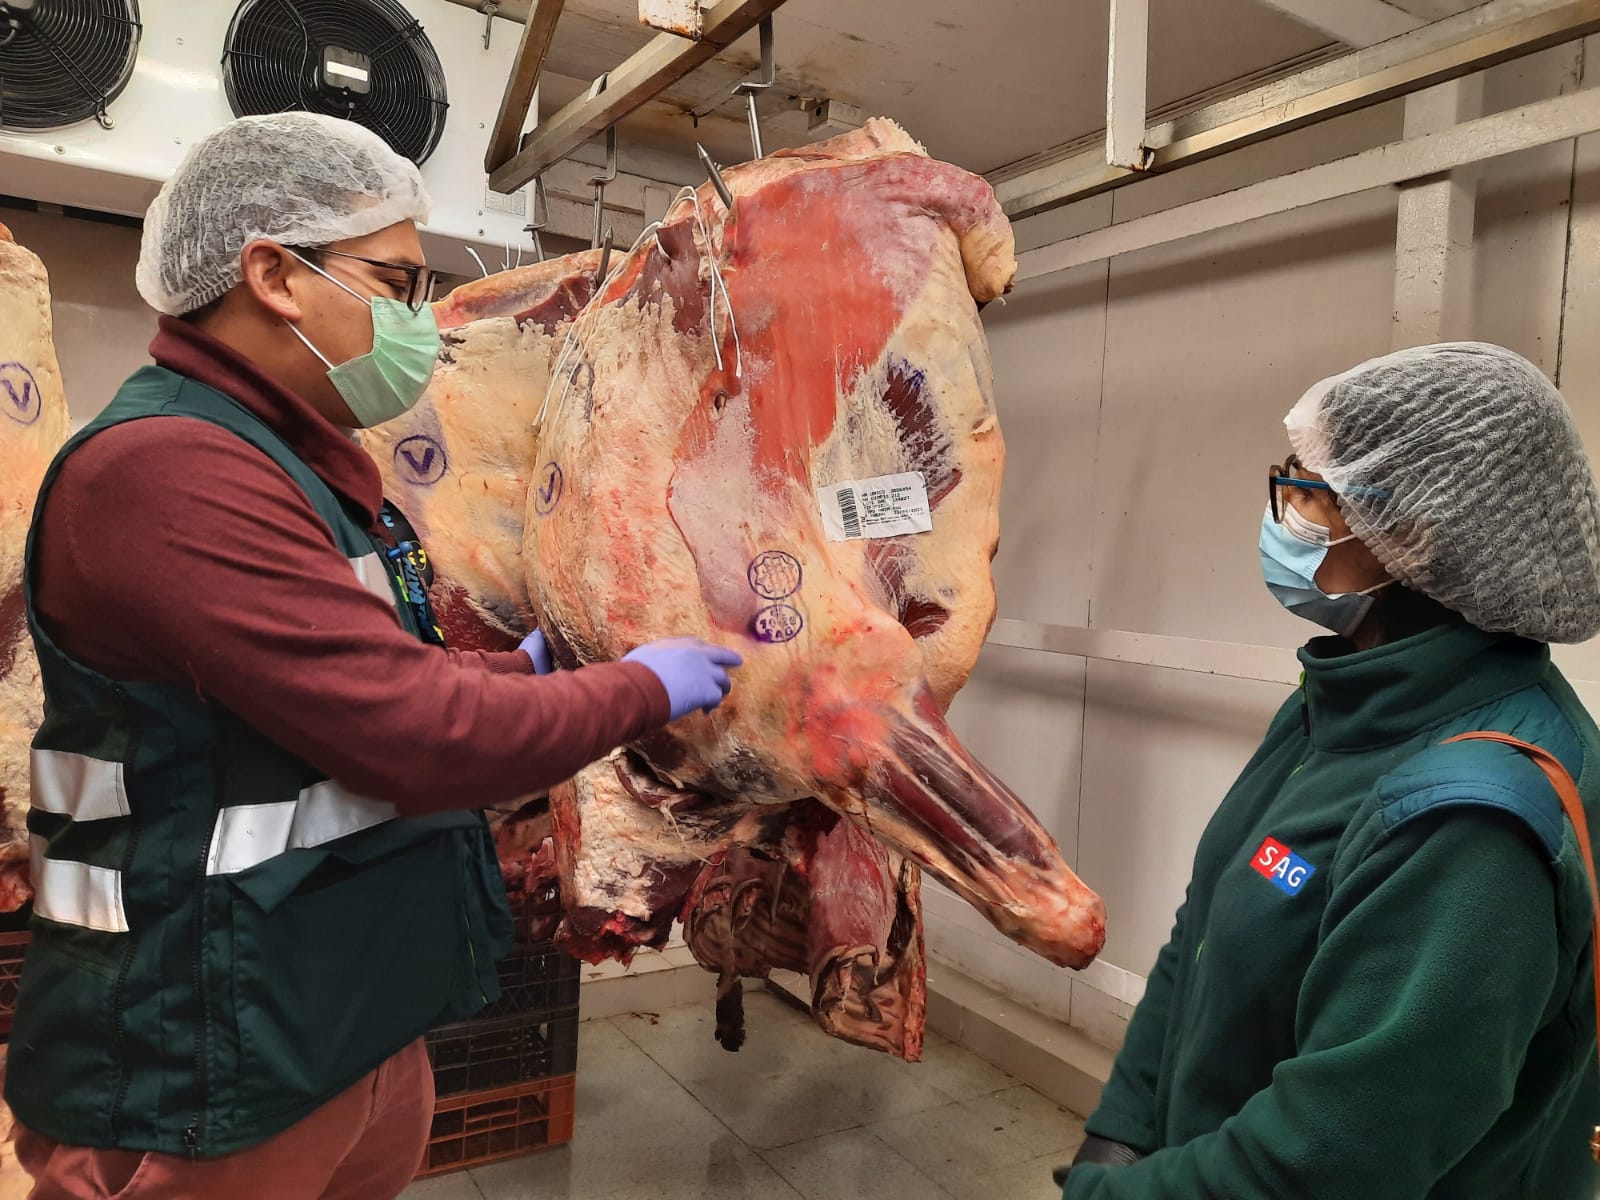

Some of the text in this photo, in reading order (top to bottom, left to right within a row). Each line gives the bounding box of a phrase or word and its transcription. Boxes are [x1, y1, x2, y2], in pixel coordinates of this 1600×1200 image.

[2, 380, 30, 412] V
[400, 448, 435, 475] V
[1258, 846, 1307, 888] SAG
